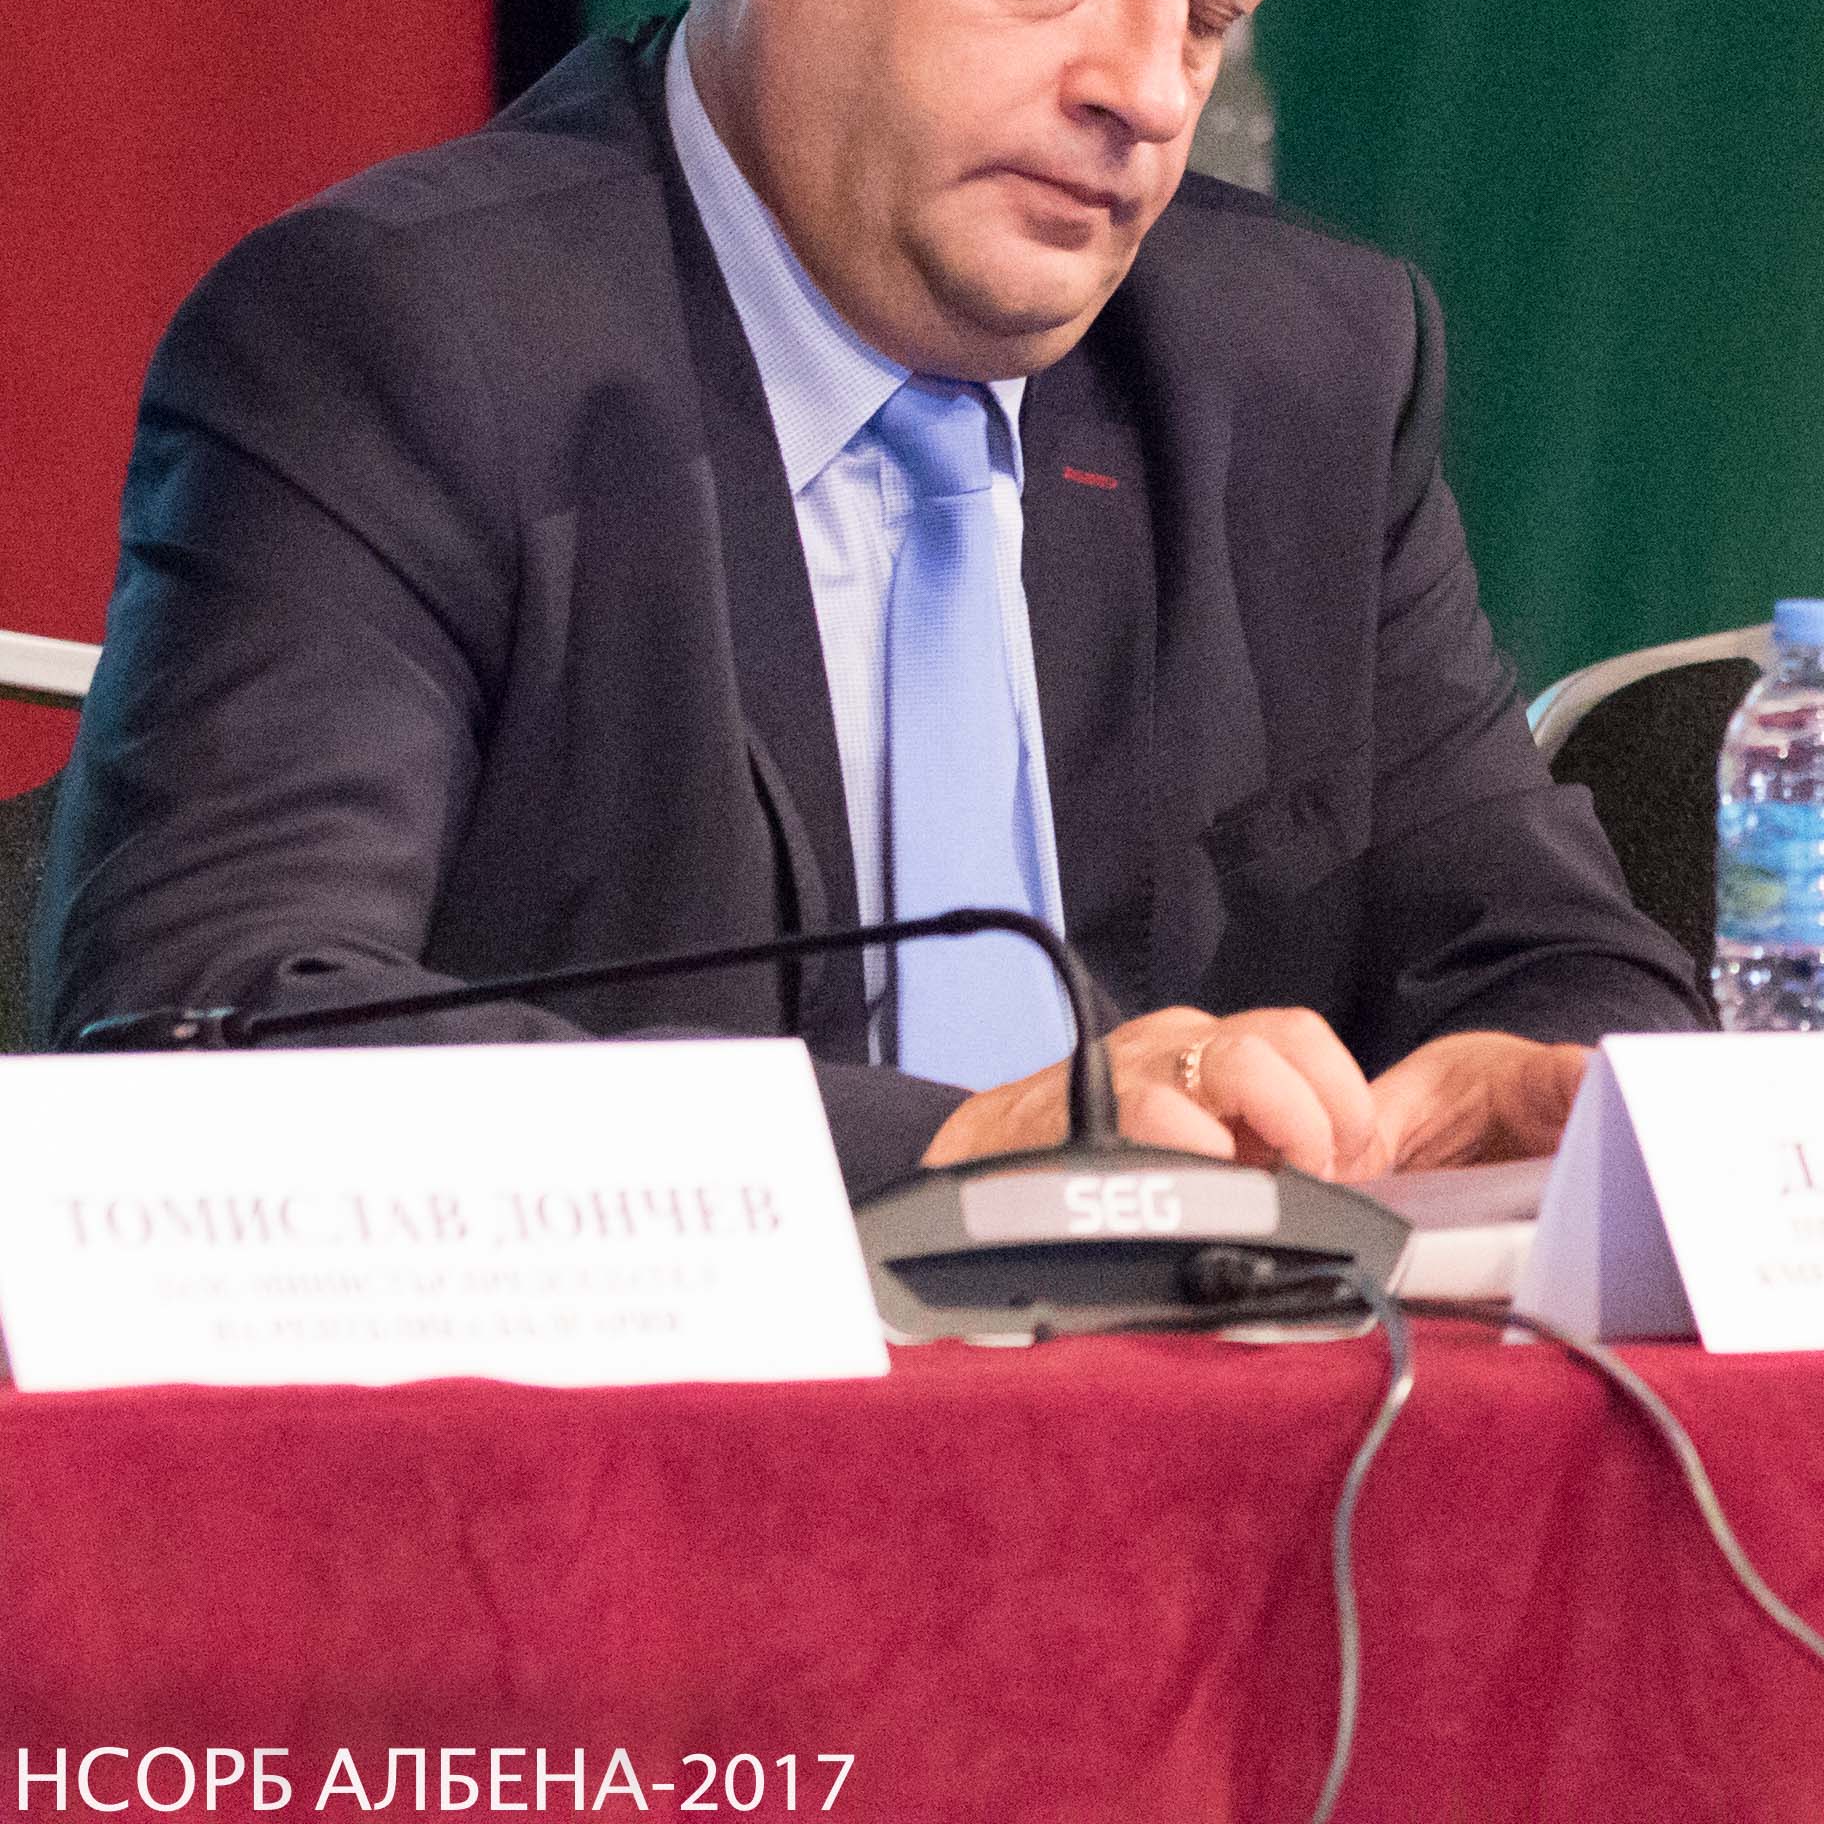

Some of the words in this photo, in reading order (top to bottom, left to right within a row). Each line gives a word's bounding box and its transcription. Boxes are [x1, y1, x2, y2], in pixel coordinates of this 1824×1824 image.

[55, 1187, 470, 1251] ТОМИСЛАВ
[490, 1183, 783, 1251] ДОНЧЕВ
[1065, 1175, 1182, 1233] SEG
